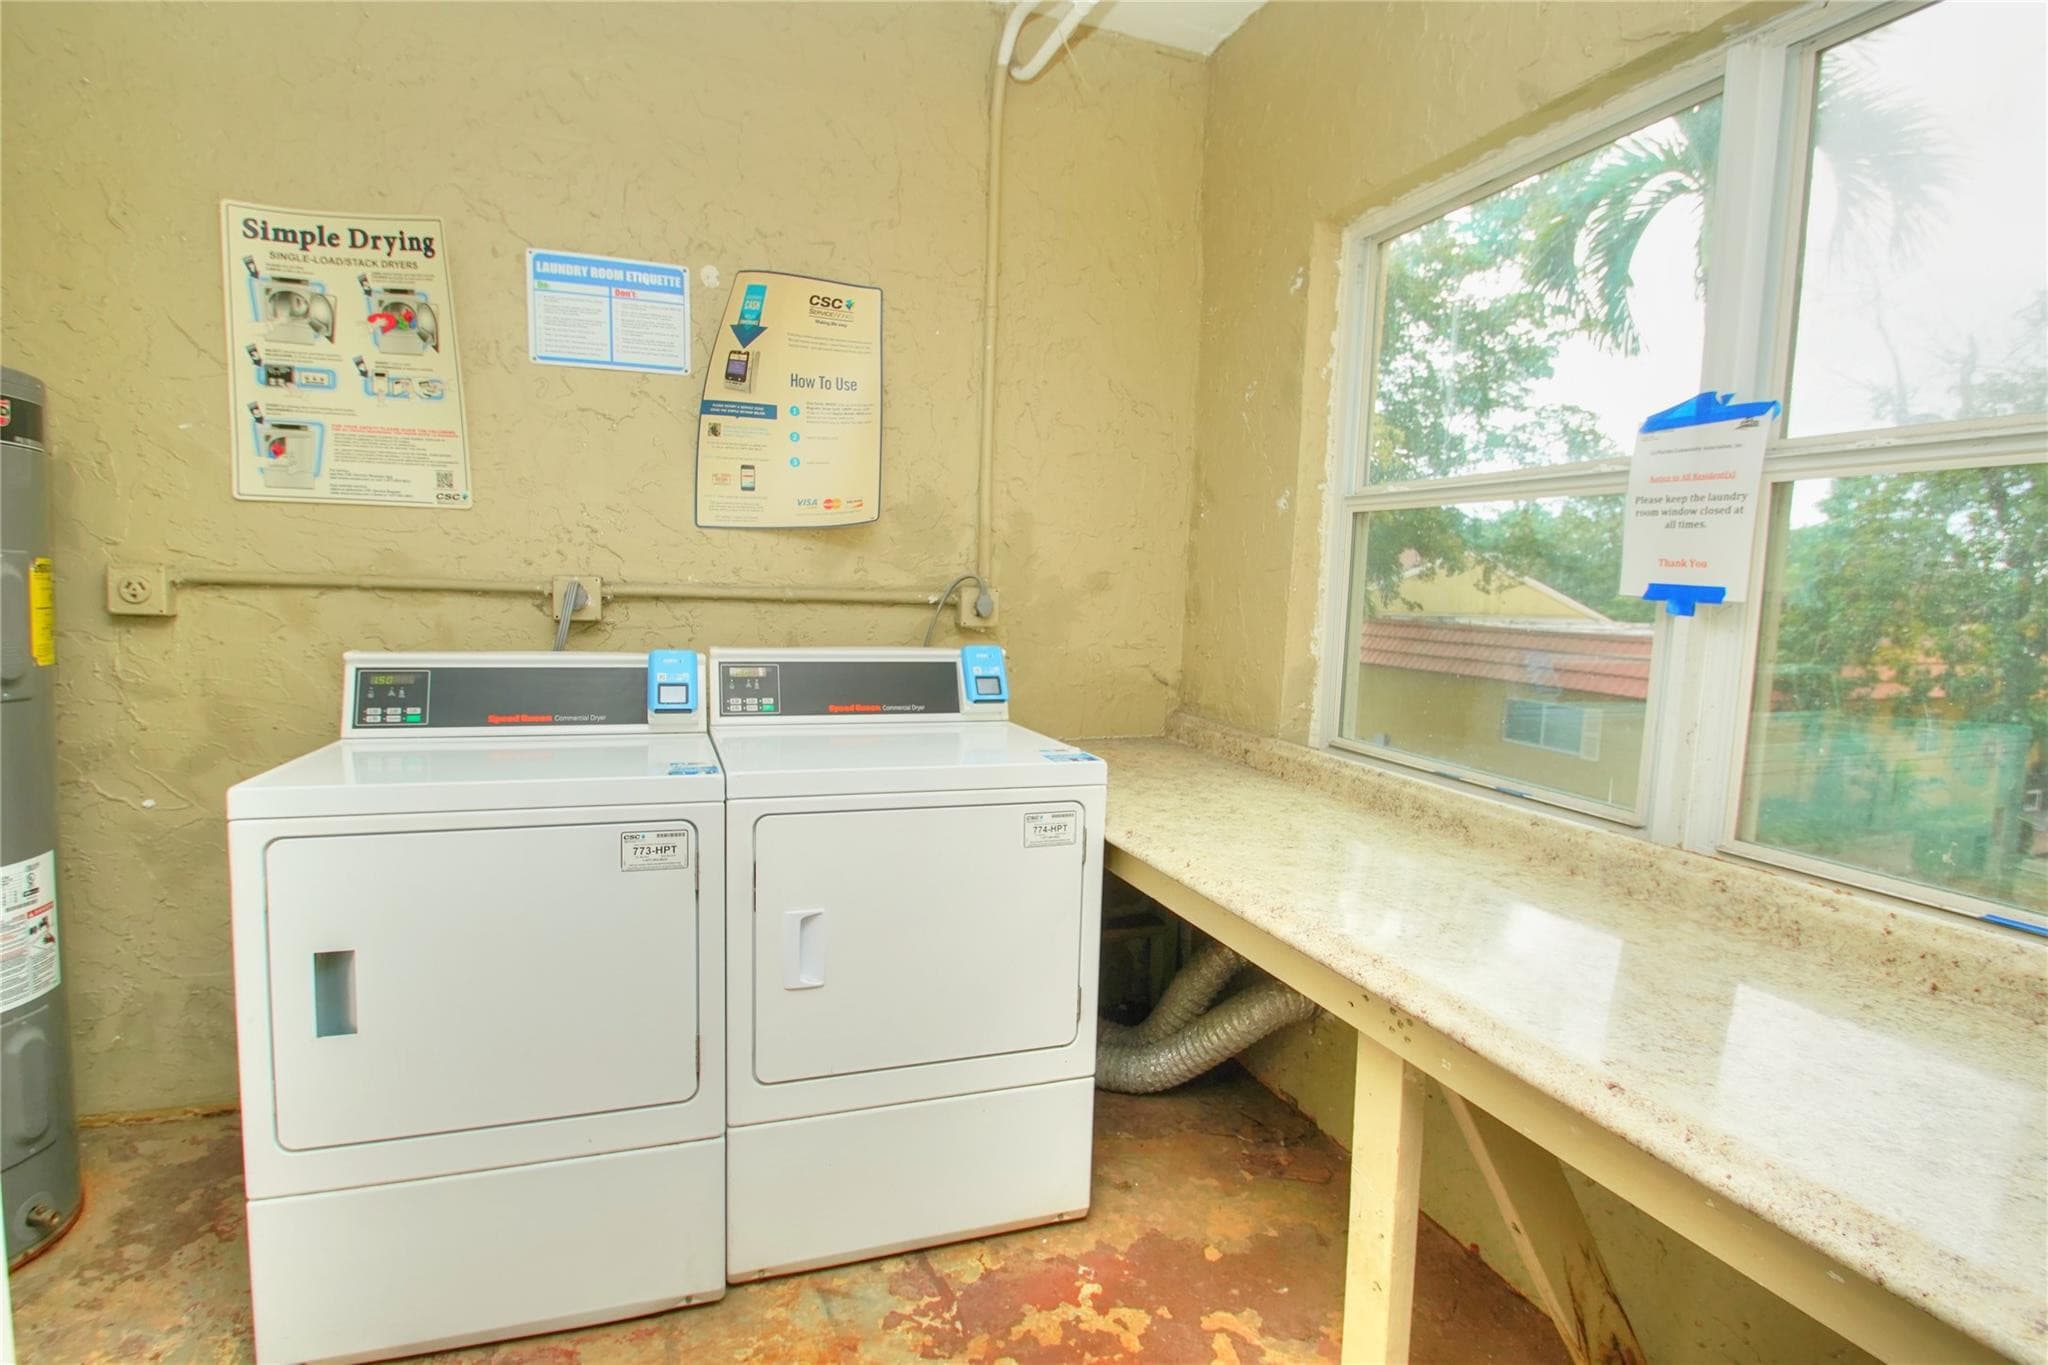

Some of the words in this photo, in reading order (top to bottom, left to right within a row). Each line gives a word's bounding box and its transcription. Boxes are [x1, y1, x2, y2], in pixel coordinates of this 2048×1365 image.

[242, 218, 341, 251] Simple
[348, 227, 436, 259] Drying
[269, 251, 379, 269] SINGLE-LOAD/STACK
[381, 256, 418, 270] DRYERS
[536, 260, 589, 278] LAUNDRY
[590, 267, 624, 282] ROOM
[626, 272, 682, 289] ETIQUETTE
[614, 289, 636, 298] Don't
[809, 295, 844, 309] CSC
[790, 373, 815, 389] How
[819, 376, 832, 390] To
[836, 376, 858, 391] Use
[436, 493, 460, 501] CSC
[797, 498, 818, 506] VISA
[1635, 495, 1662, 505] Please
[1665, 494, 1688, 506] keep
[1690, 493, 1706, 503] the
[1708, 492, 1748, 503] laundry
[1635, 508, 1659, 517] room
[1661, 506, 1697, 517] window
[1700, 506, 1732, 516] closed
[1734, 506, 1744, 515] at
[1664, 520, 1676, 529] all
[1678, 519, 1707, 529] times.
[1658, 558, 1687, 568] Thank
[1689, 559, 1708, 568] You
[911, 704, 925, 712] Dryer
[554, 714, 589, 722] Commercial
[590, 714, 606, 723] Dryer
[1033, 824, 1068, 833] 774-HPT
[633, 845, 677, 856] 773-HPT
